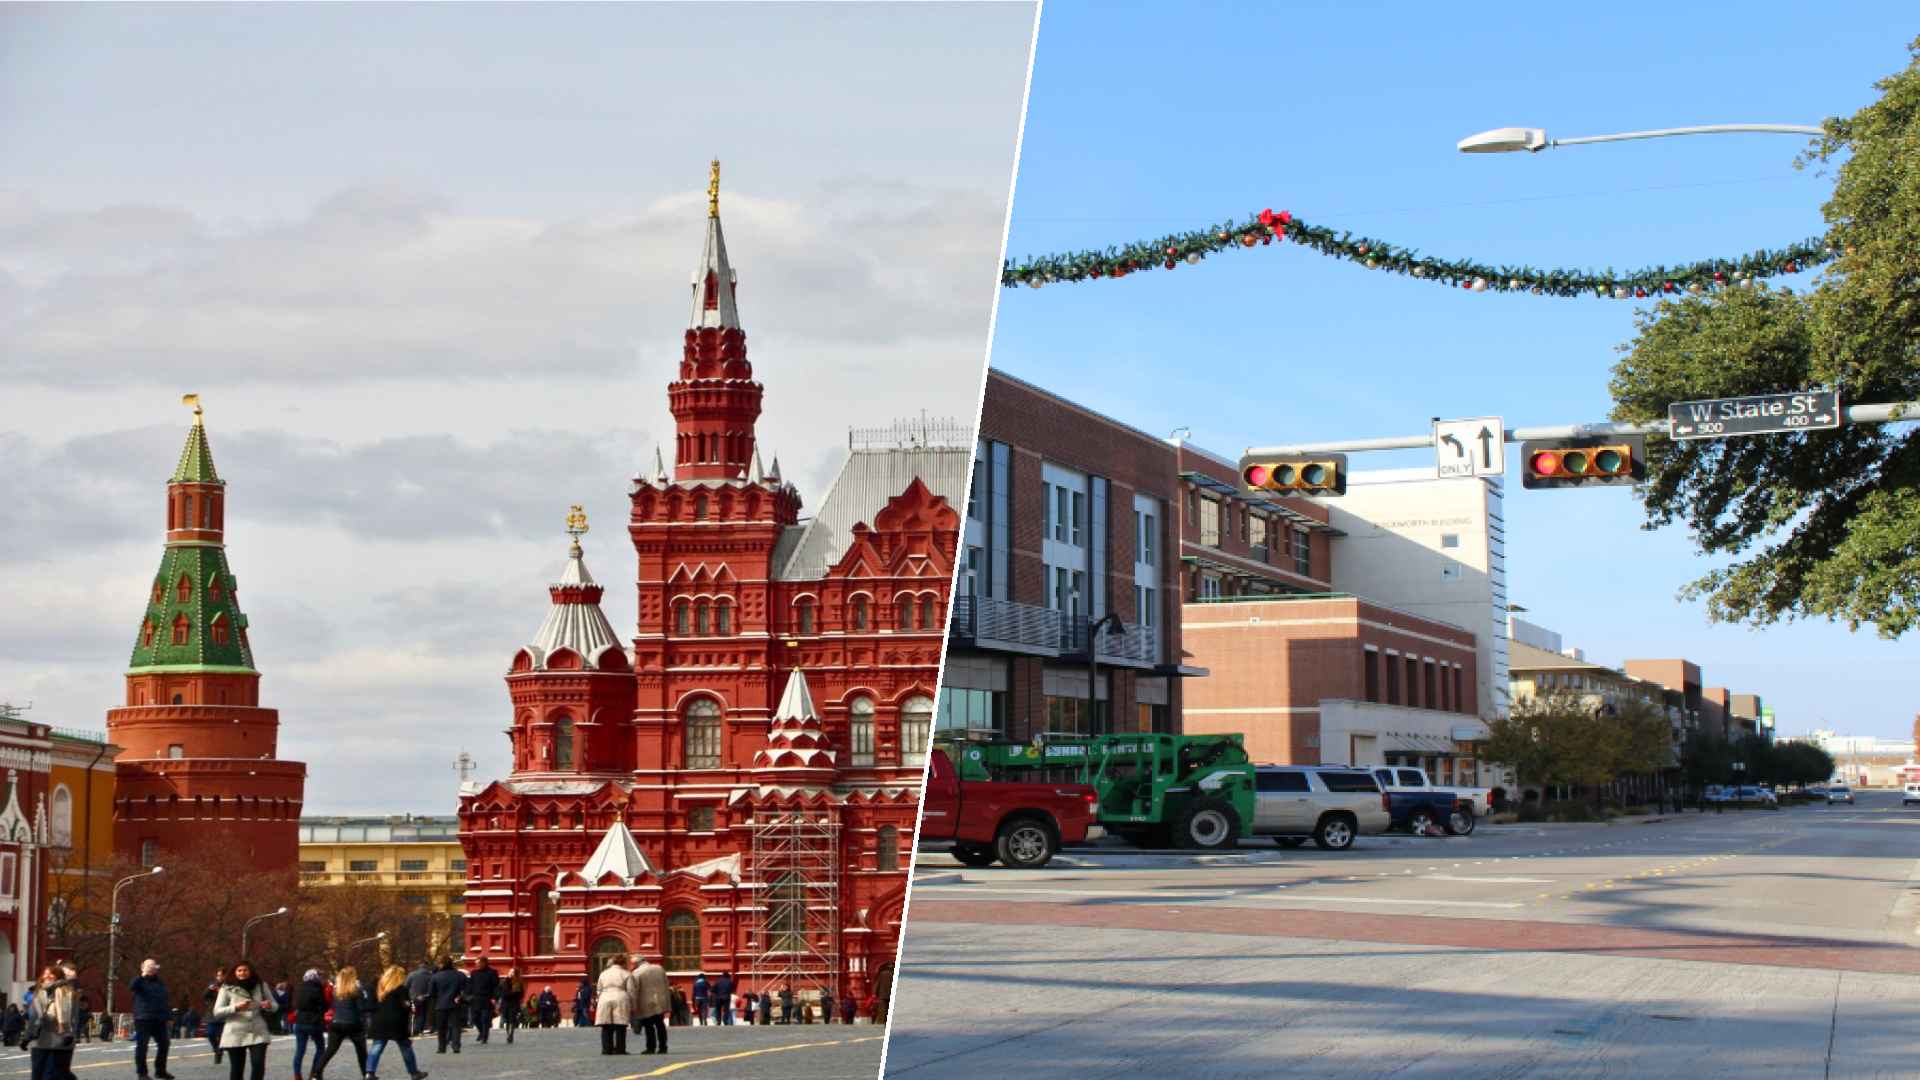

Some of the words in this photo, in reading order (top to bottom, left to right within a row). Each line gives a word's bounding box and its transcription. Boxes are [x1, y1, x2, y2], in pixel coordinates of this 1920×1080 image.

[1690, 404, 1713, 421] W
[1720, 400, 1785, 419] State
[1791, 396, 1817, 414] St
[1783, 415, 1809, 426] 400
[1440, 464, 1471, 474] ONLY
